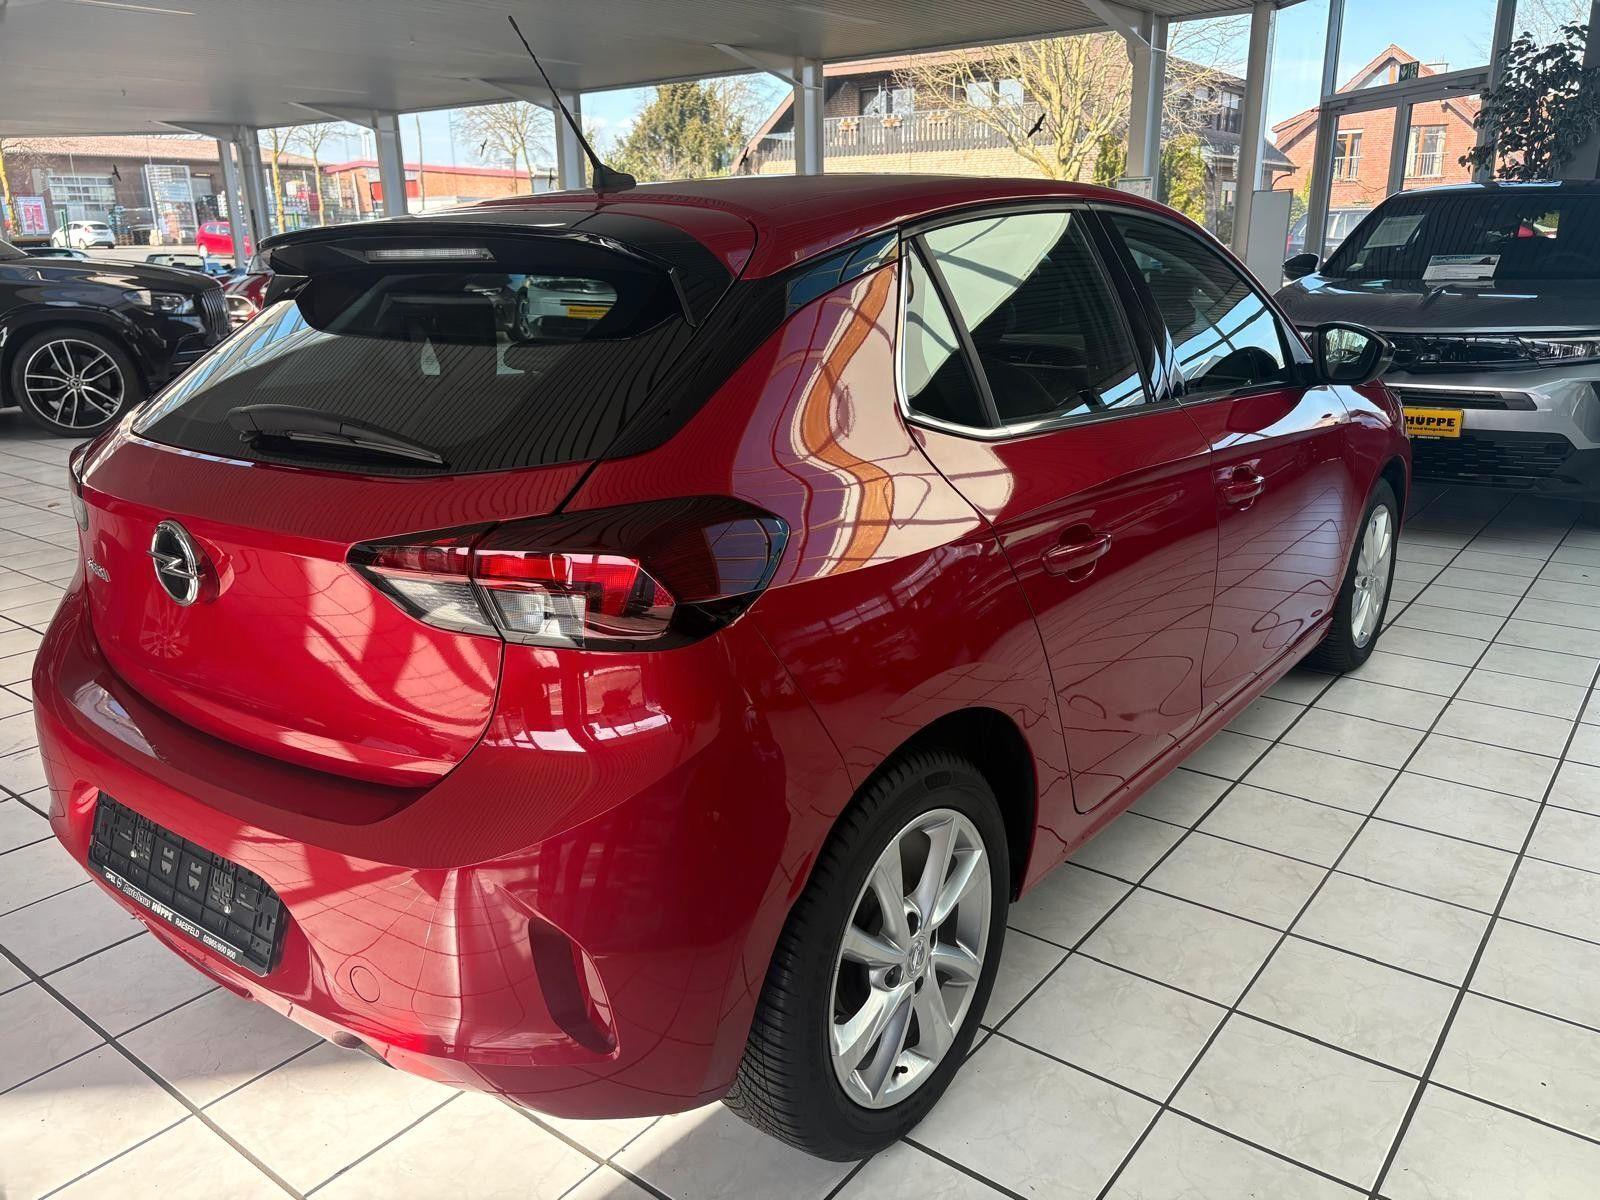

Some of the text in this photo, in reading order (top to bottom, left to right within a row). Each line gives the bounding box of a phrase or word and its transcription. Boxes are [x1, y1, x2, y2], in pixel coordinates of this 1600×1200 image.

[1405, 414, 1456, 427] HÜPPE
[105, 872, 116, 884] OPEL
[122, 884, 151, 908] Autohaus
[151, 902, 174, 922] HÜPPE
[175, 917, 200, 938] RAESFELD
